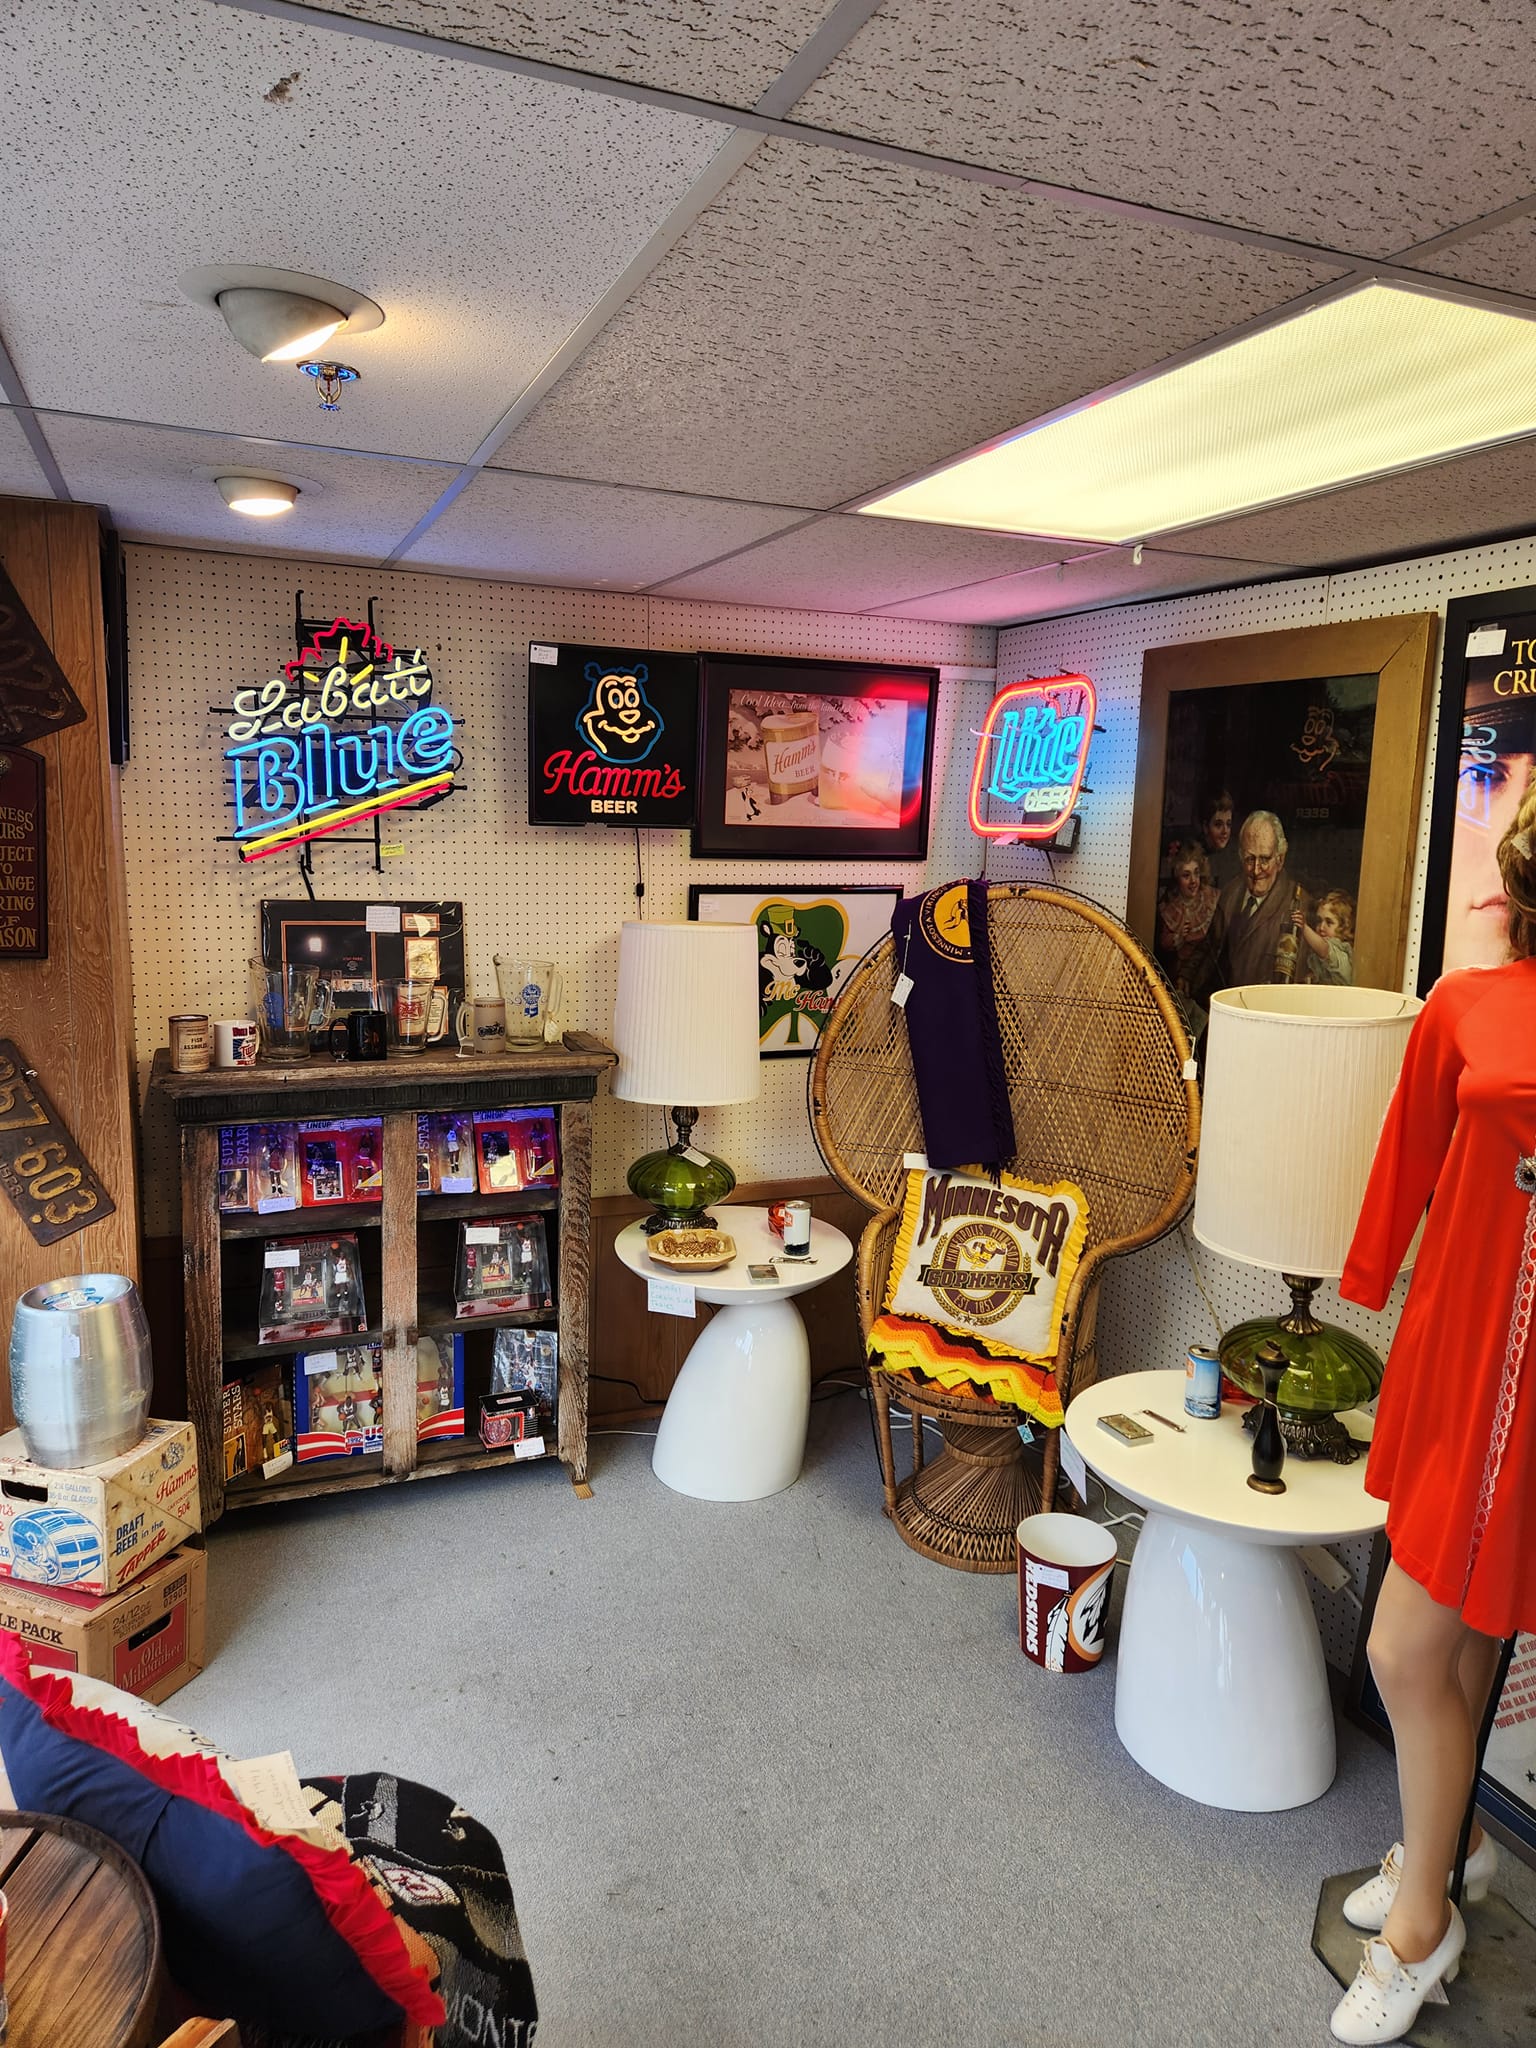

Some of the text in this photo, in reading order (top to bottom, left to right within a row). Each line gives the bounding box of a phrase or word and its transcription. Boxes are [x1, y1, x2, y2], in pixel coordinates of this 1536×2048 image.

[225, 706, 454, 838] Blue
[543, 750, 686, 798] Hamm's
[773, 742, 816, 775] Hamm's
[794, 766, 816, 778] BEER
[590, 799, 638, 814] BEER
[924, 885, 964, 956] MINNESOTA VIKINGS
[762, 980, 801, 1001] Mc
[306, 1120, 332, 1130] LINEUP
[917, 1173, 1070, 1279] MINNESOTA
[946, 1223, 1019, 1268] MINNEAPOLIS MINNESOTA
[953, 1293, 996, 1314] EST 1851
[222, 1388, 232, 1434] SUPER
[231, 1385, 243, 1429] STARS
[156, 1463, 198, 1505] Hamm's
[115, 1520, 164, 1556] BEER in the
[116, 1513, 145, 1541] DRAFT
[115, 1528, 168, 1584] TAPPER
[20, 1618, 64, 1645] PACK
[141, 1637, 163, 1665] Old
[120, 1642, 183, 1689] Milwaukee
